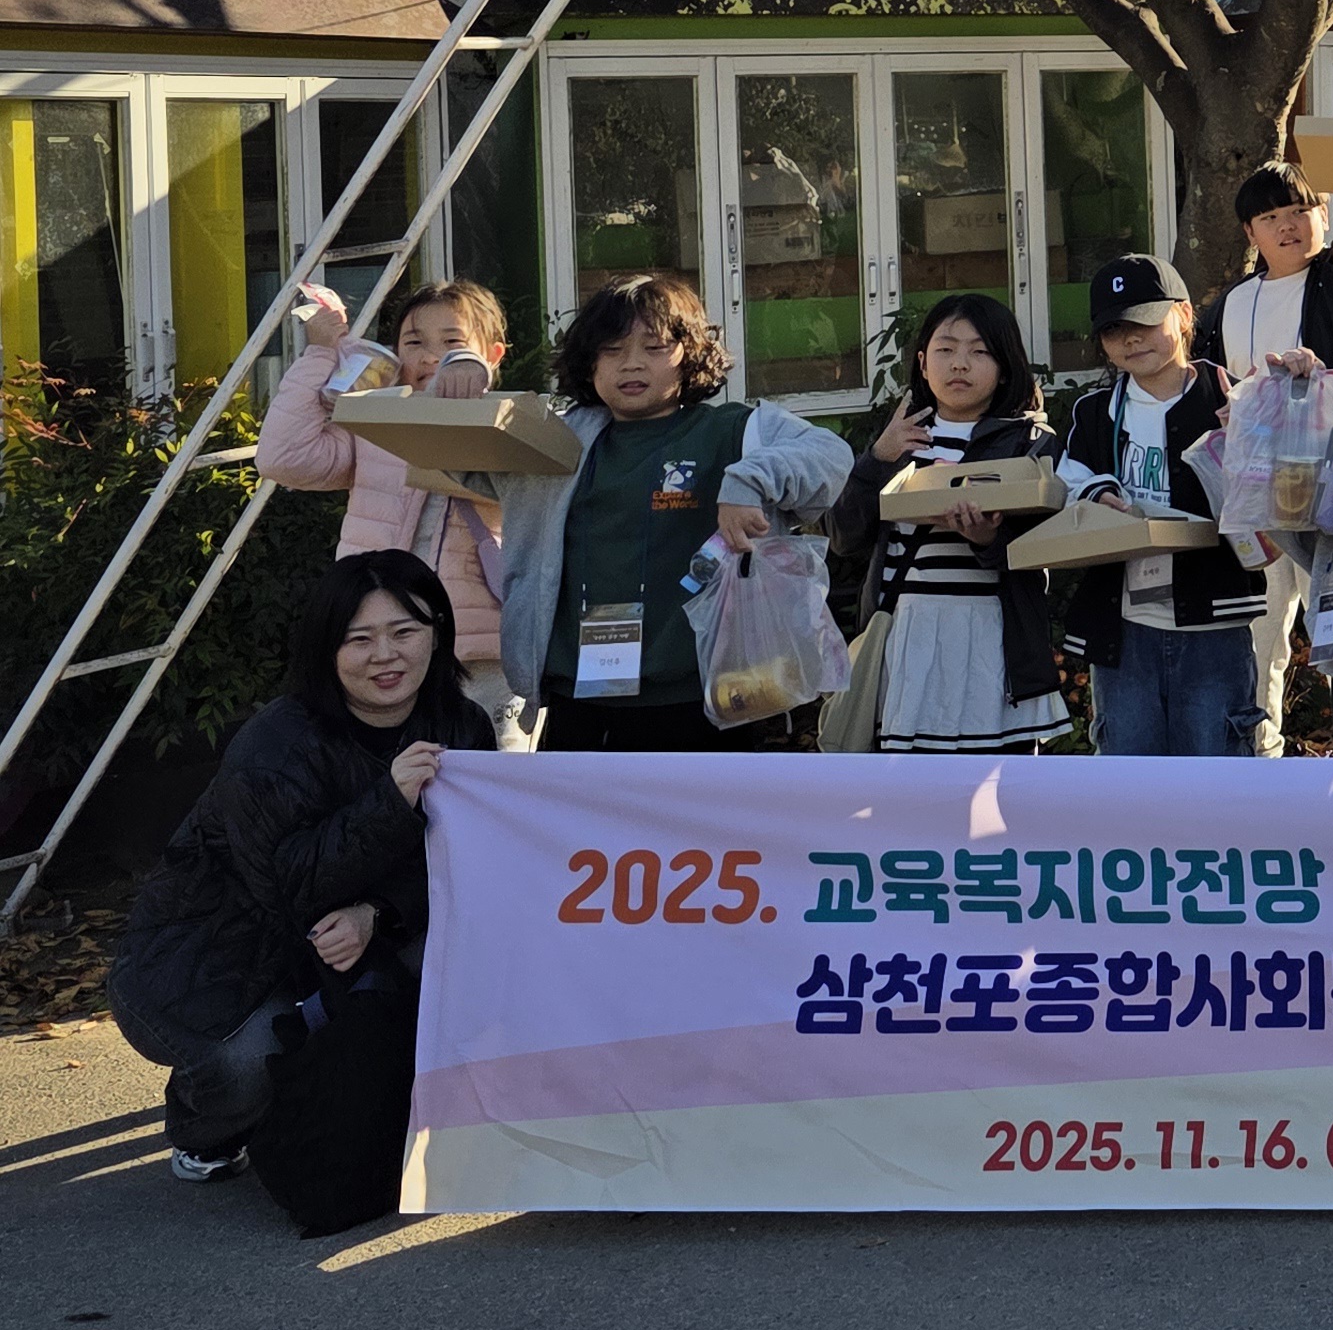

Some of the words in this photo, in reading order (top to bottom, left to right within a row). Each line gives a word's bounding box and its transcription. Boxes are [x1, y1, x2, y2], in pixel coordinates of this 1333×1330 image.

[1112, 276, 1125, 293] C
[558, 848, 778, 924] 2025.
[803, 847, 1326, 924] 교육복지안전망
[983, 1119, 1138, 1174] 2025.
